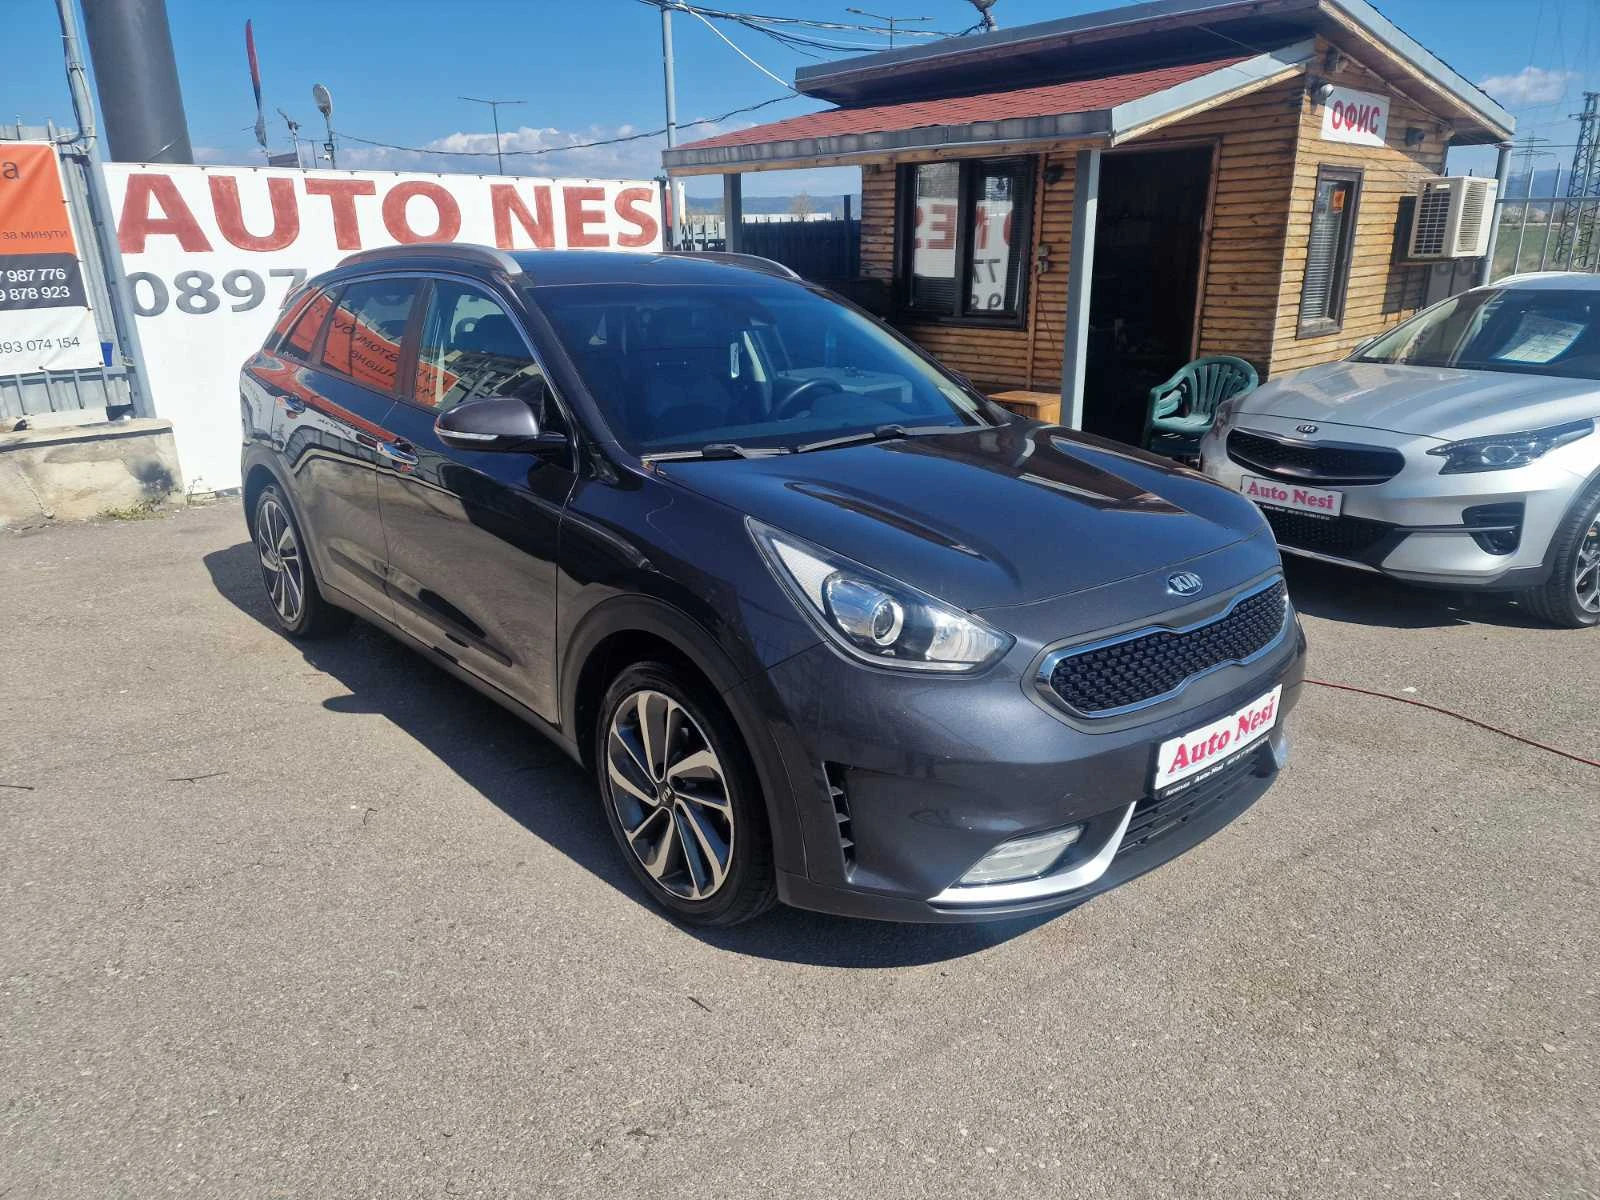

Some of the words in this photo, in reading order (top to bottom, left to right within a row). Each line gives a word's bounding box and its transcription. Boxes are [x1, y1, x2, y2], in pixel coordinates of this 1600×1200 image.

[1331, 100, 1381, 134] ОФИС
[117, 173, 462, 253] AUTO
[490, 184, 659, 249] NES
[3, 231, 20, 241] за
[21, 229, 68, 242] минути
[7, 269, 35, 283] 987
[39, 267, 67, 281] 776
[10, 287, 39, 301] 878
[43, 285, 70, 299] 923
[27, 338, 52, 352] 074
[56, 336, 81, 349] 154
[1246, 479, 1288, 501] Auto
[1292, 489, 1334, 510] Nesi
[1171, 573, 1200, 592] KIA
[1168, 729, 1230, 773] Auto
[1234, 696, 1276, 741] Nesi
